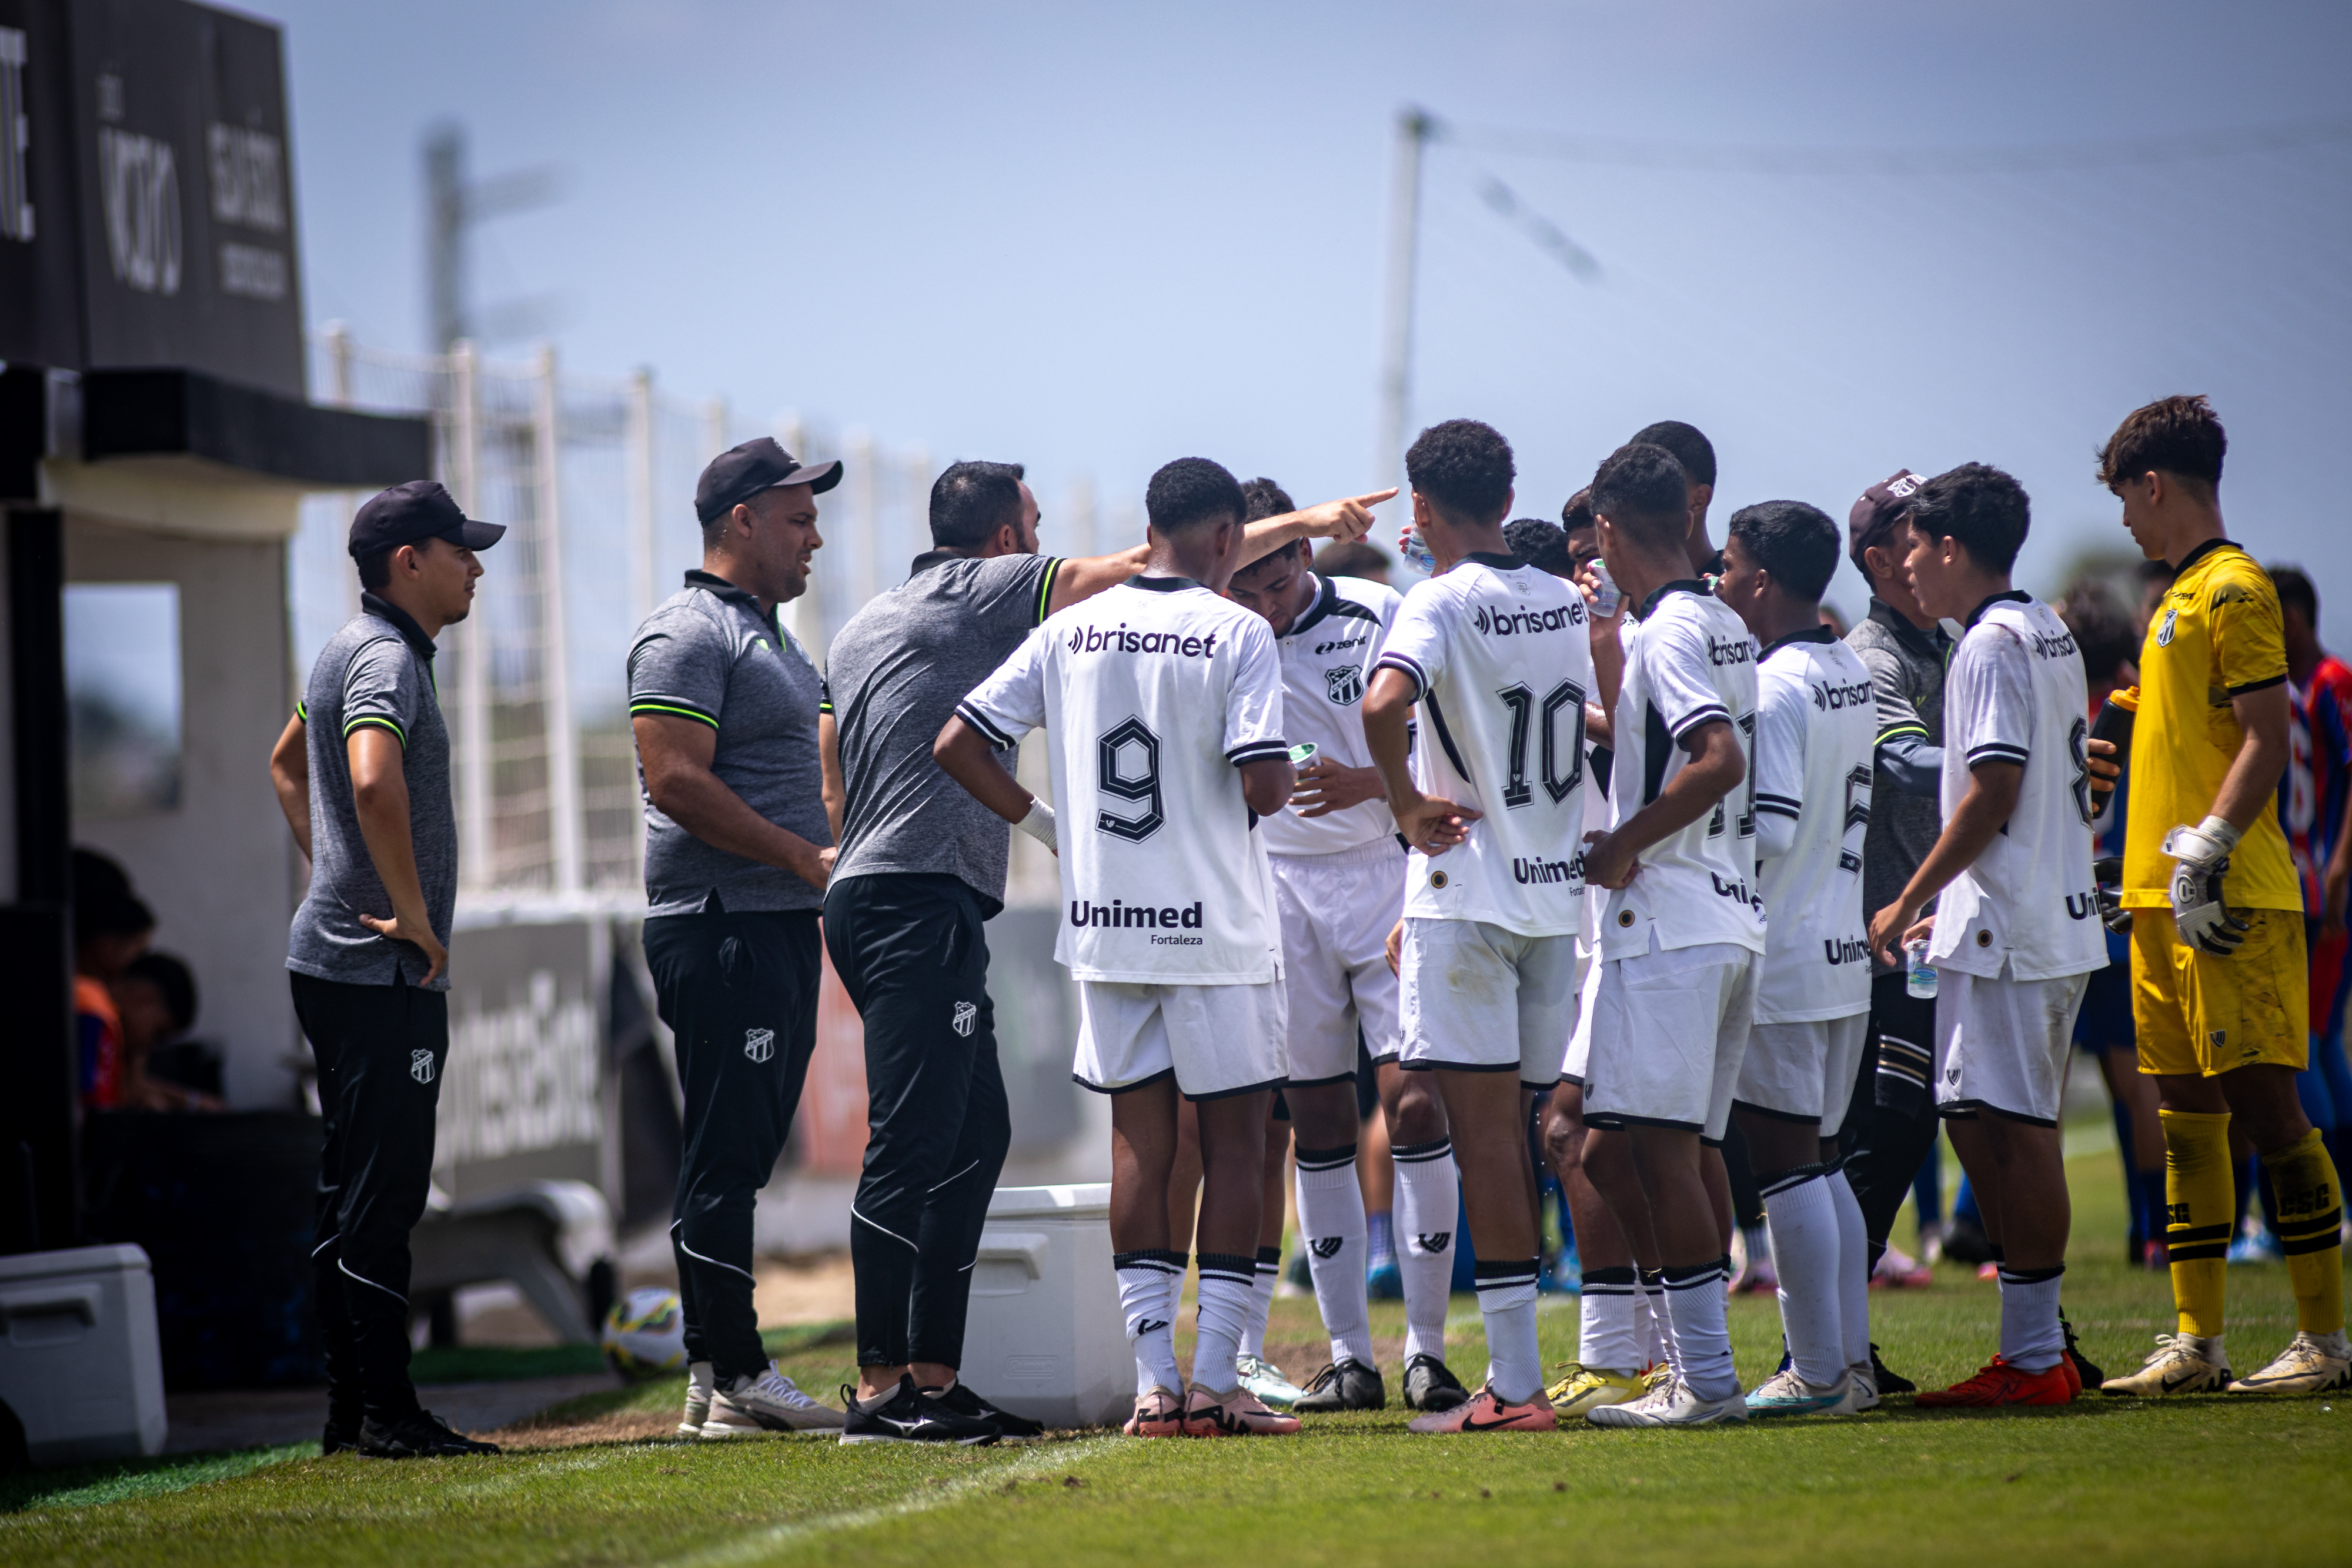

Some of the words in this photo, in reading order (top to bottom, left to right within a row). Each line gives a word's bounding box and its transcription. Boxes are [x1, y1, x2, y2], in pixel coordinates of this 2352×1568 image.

[1490, 596, 1589, 636] brisanet
[1085, 623, 1216, 658] brisanet
[1337, 636, 1367, 650] zenir
[1496, 677, 1588, 810] 10
[1095, 714, 1166, 845] 9
[1514, 850, 1585, 884] Unimed
[1071, 899, 1202, 929] Unimed
[1151, 934, 1203, 945] Fortaleza
